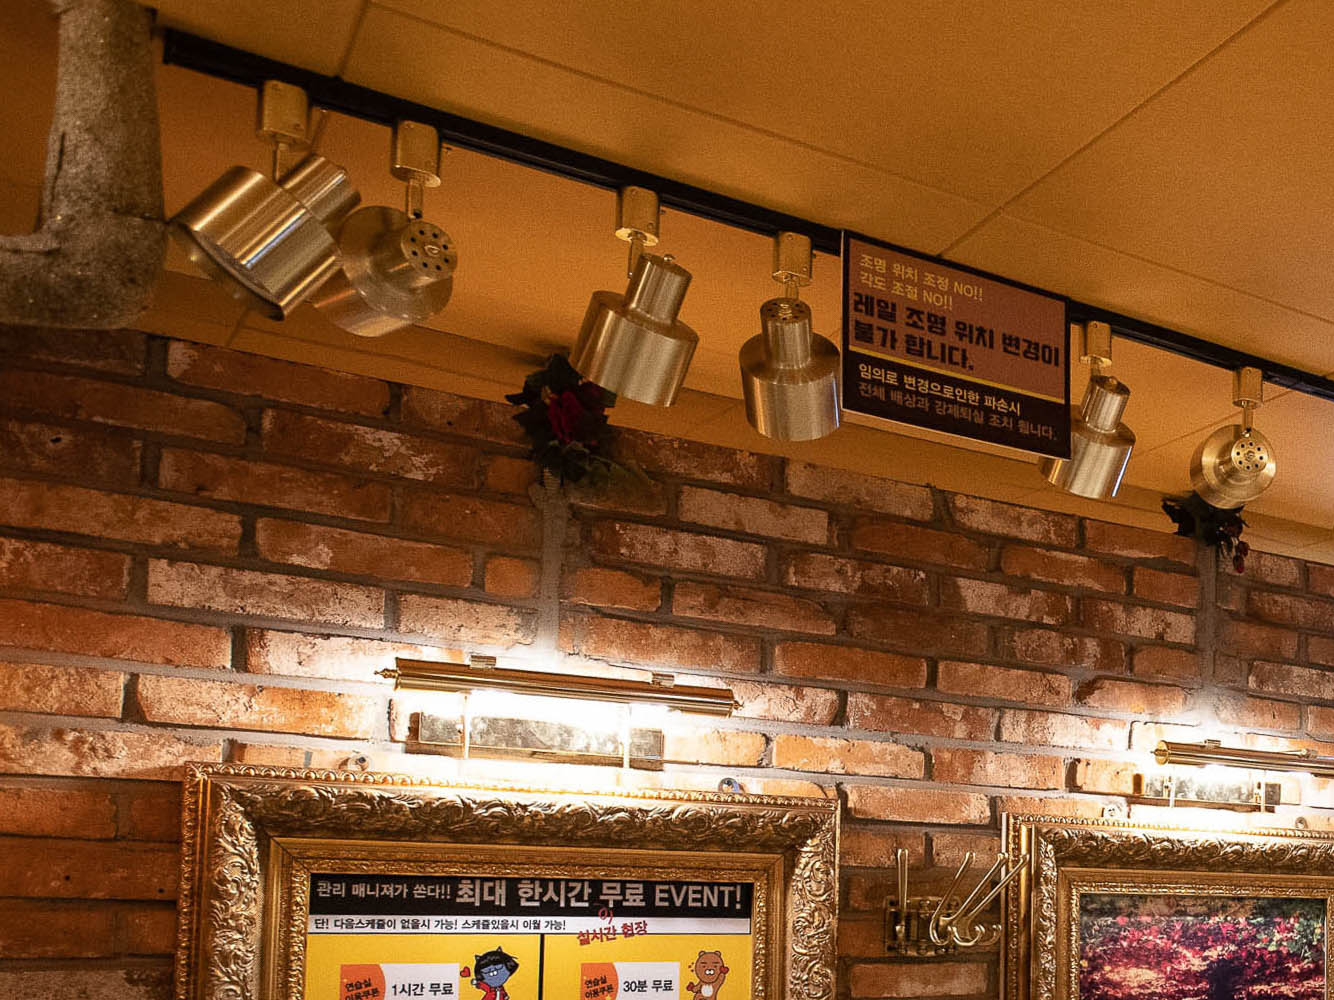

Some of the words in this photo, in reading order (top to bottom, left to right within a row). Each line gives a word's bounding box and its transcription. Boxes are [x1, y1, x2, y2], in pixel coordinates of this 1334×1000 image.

[860, 254, 886, 272] 조명
[892, 262, 918, 283] 위치
[953, 281, 983, 302] NO!!
[860, 272, 886, 290] 각도
[923, 290, 953, 310] NO!!
[853, 292, 897, 323] 레일
[905, 306, 947, 337] 조명
[955, 320, 994, 350] 위치
[1002, 331, 1059, 367] 변경이
[854, 319, 897, 350] 불가
[904, 333, 975, 371] 합니다.
[859, 363, 898, 385] 임의로
[903, 374, 980, 405] 변경으로인한
[984, 394, 1021, 417] 파손시
[317, 882, 346, 898] 관리
[351, 882, 408, 898] 매니져가
[413, 883, 450, 899] 쏜다!!
[456, 879, 506, 906] 최대
[518, 880, 592, 908] 한시간
[600, 882, 646, 908] 무료
[655, 885, 742, 910] EVENT!
[314, 918, 329, 930] 단!
[401, 918, 430, 930] 없을시
[434, 918, 457, 931] 가능!
[523, 919, 541, 931] 이월
[544, 920, 566, 931] 가능!
[345, 978, 371, 992] 연습실
[392, 984, 424, 997] 1시간
[428, 983, 454, 996] 무료
[623, 980, 648, 993] 30분
[652, 980, 674, 993] 무료
